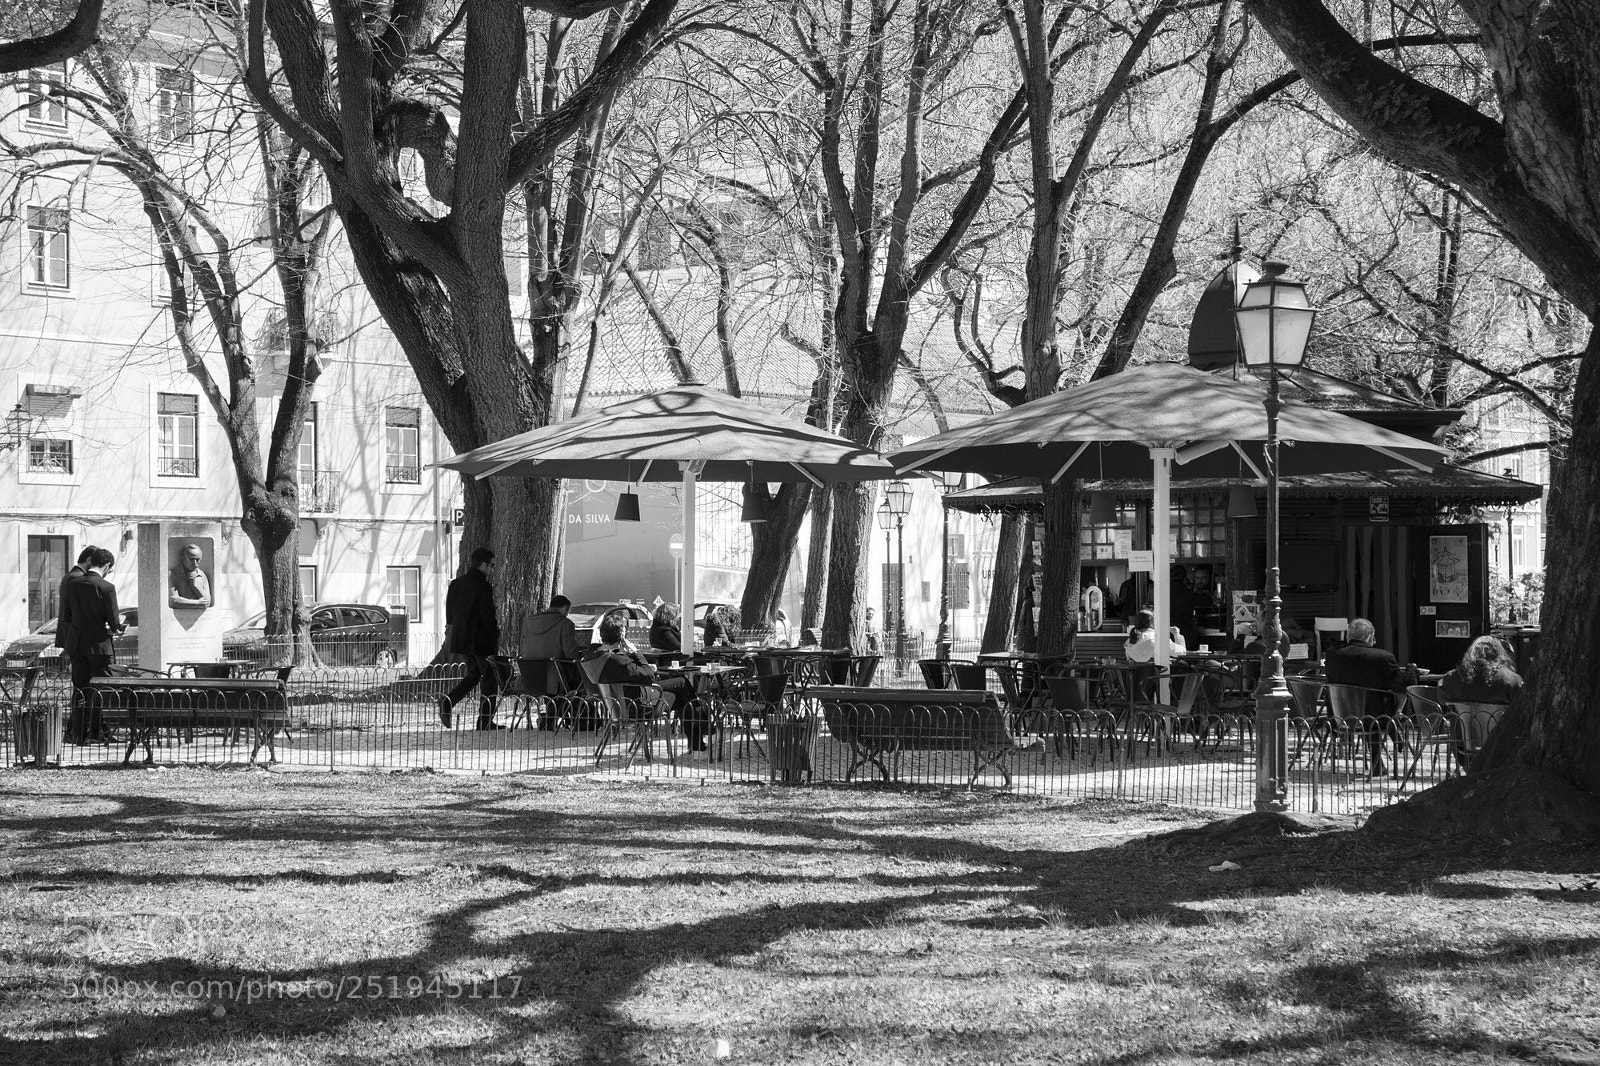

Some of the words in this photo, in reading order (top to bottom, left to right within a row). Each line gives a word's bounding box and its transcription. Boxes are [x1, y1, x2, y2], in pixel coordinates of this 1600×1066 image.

[456, 510, 464, 522] P
[568, 514, 582, 524] DA
[585, 514, 611, 524] SILVA
